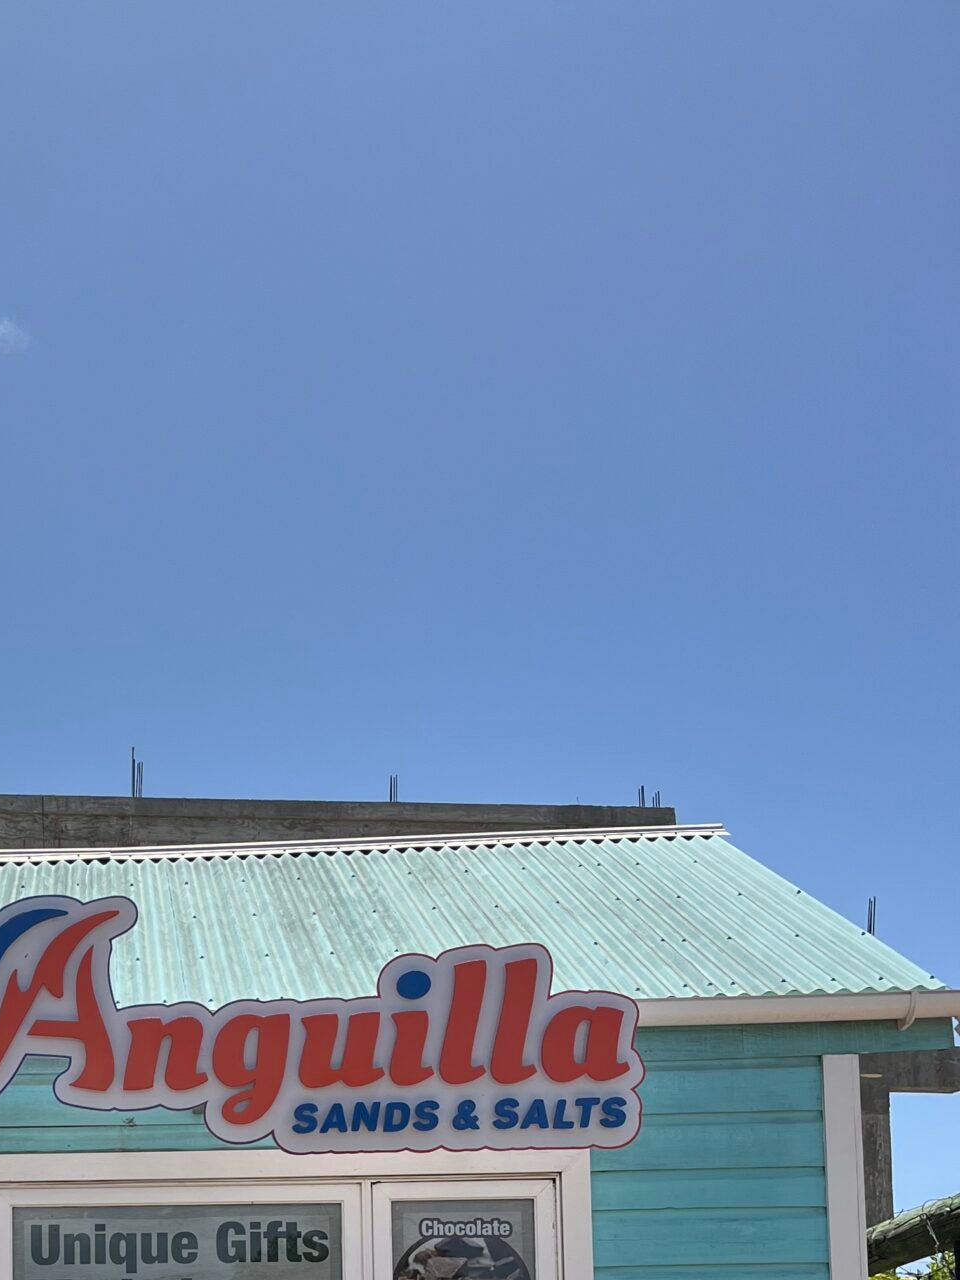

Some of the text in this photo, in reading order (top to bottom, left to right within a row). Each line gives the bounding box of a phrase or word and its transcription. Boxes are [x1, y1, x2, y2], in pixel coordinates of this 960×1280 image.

[292, 1096, 628, 1134] SANDS & SALTS
[30, 1220, 330, 1274] Unique Gifts
[421, 1219, 511, 1237] Chocolate
